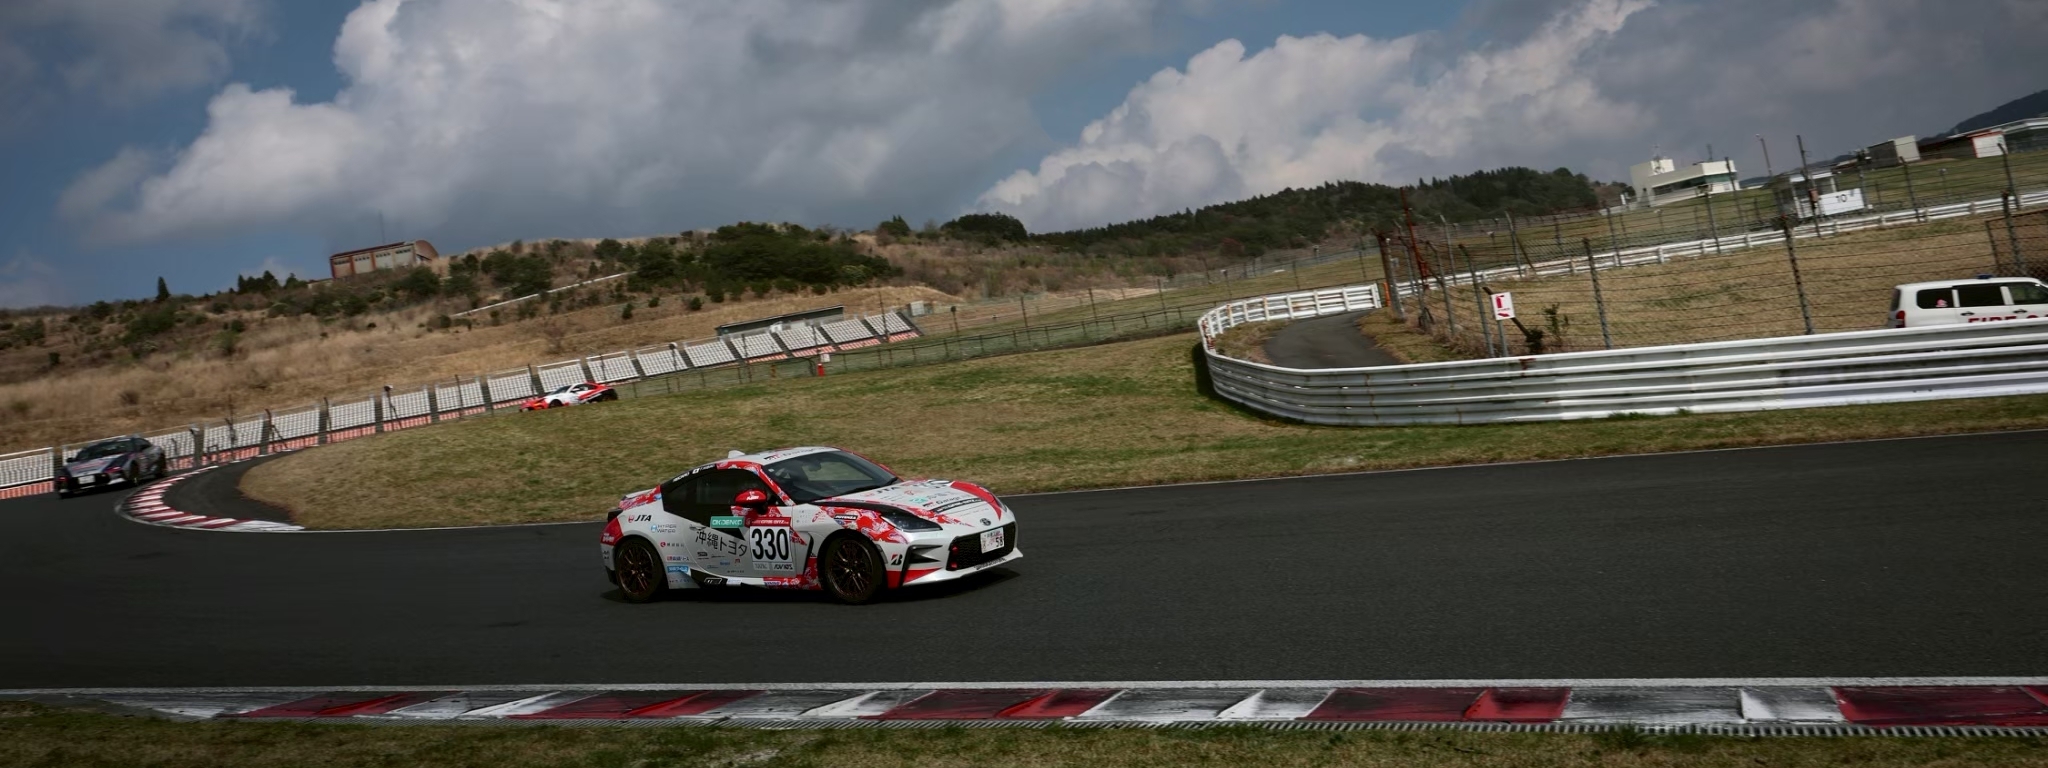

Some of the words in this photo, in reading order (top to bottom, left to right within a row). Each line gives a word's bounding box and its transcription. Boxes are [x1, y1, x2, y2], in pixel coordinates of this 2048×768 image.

[634, 514, 652, 522] JTA
[695, 530, 748, 557] 沖縄トヨタ
[751, 528, 789, 560] 330
